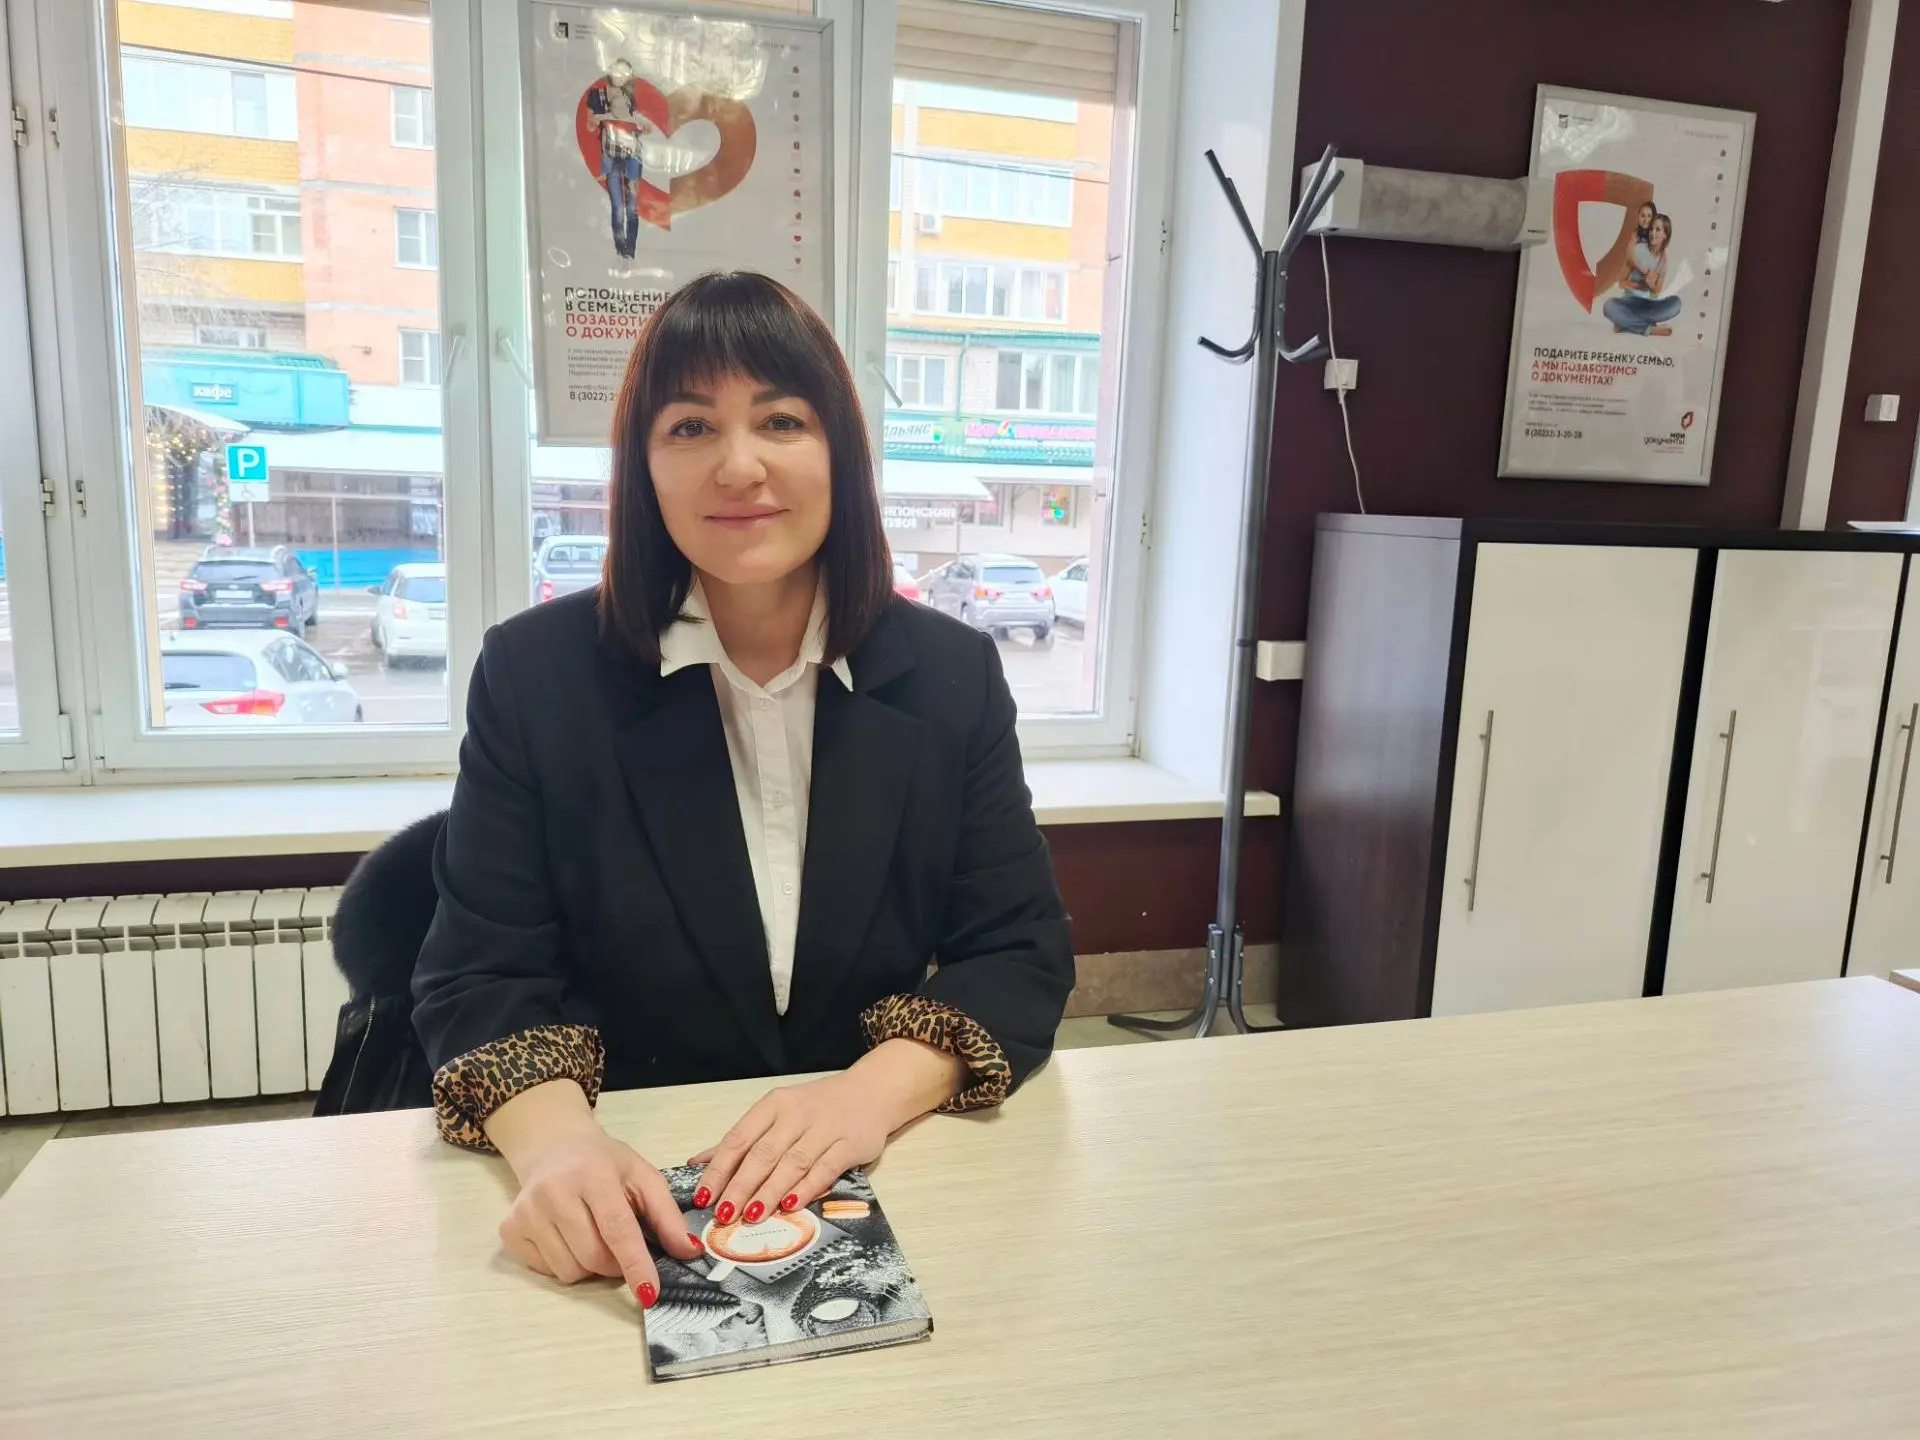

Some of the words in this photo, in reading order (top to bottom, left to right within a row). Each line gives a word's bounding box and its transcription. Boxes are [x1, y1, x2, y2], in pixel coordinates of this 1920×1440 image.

[565, 300, 573, 312] В
[578, 301, 660, 315] СЕМЕЙСТВ
[566, 313, 647, 327] ПОЗАБОТИ
[566, 327, 577, 338] О
[581, 327, 640, 339] ДОКУМ
[1534, 347, 1588, 361] ПОДАРИТЕ
[1532, 360, 1539, 370] А
[1542, 363, 1558, 372] МЫ
[1561, 363, 1637, 376] ПОЗАБОТИМСЯ
[1532, 372, 1539, 381] О
[1541, 372, 1613, 386] ДОКУМЕНТАХ!
[569, 391, 576, 401] 8
[578, 391, 608, 402] (3022)
[237, 449, 260, 478] P
